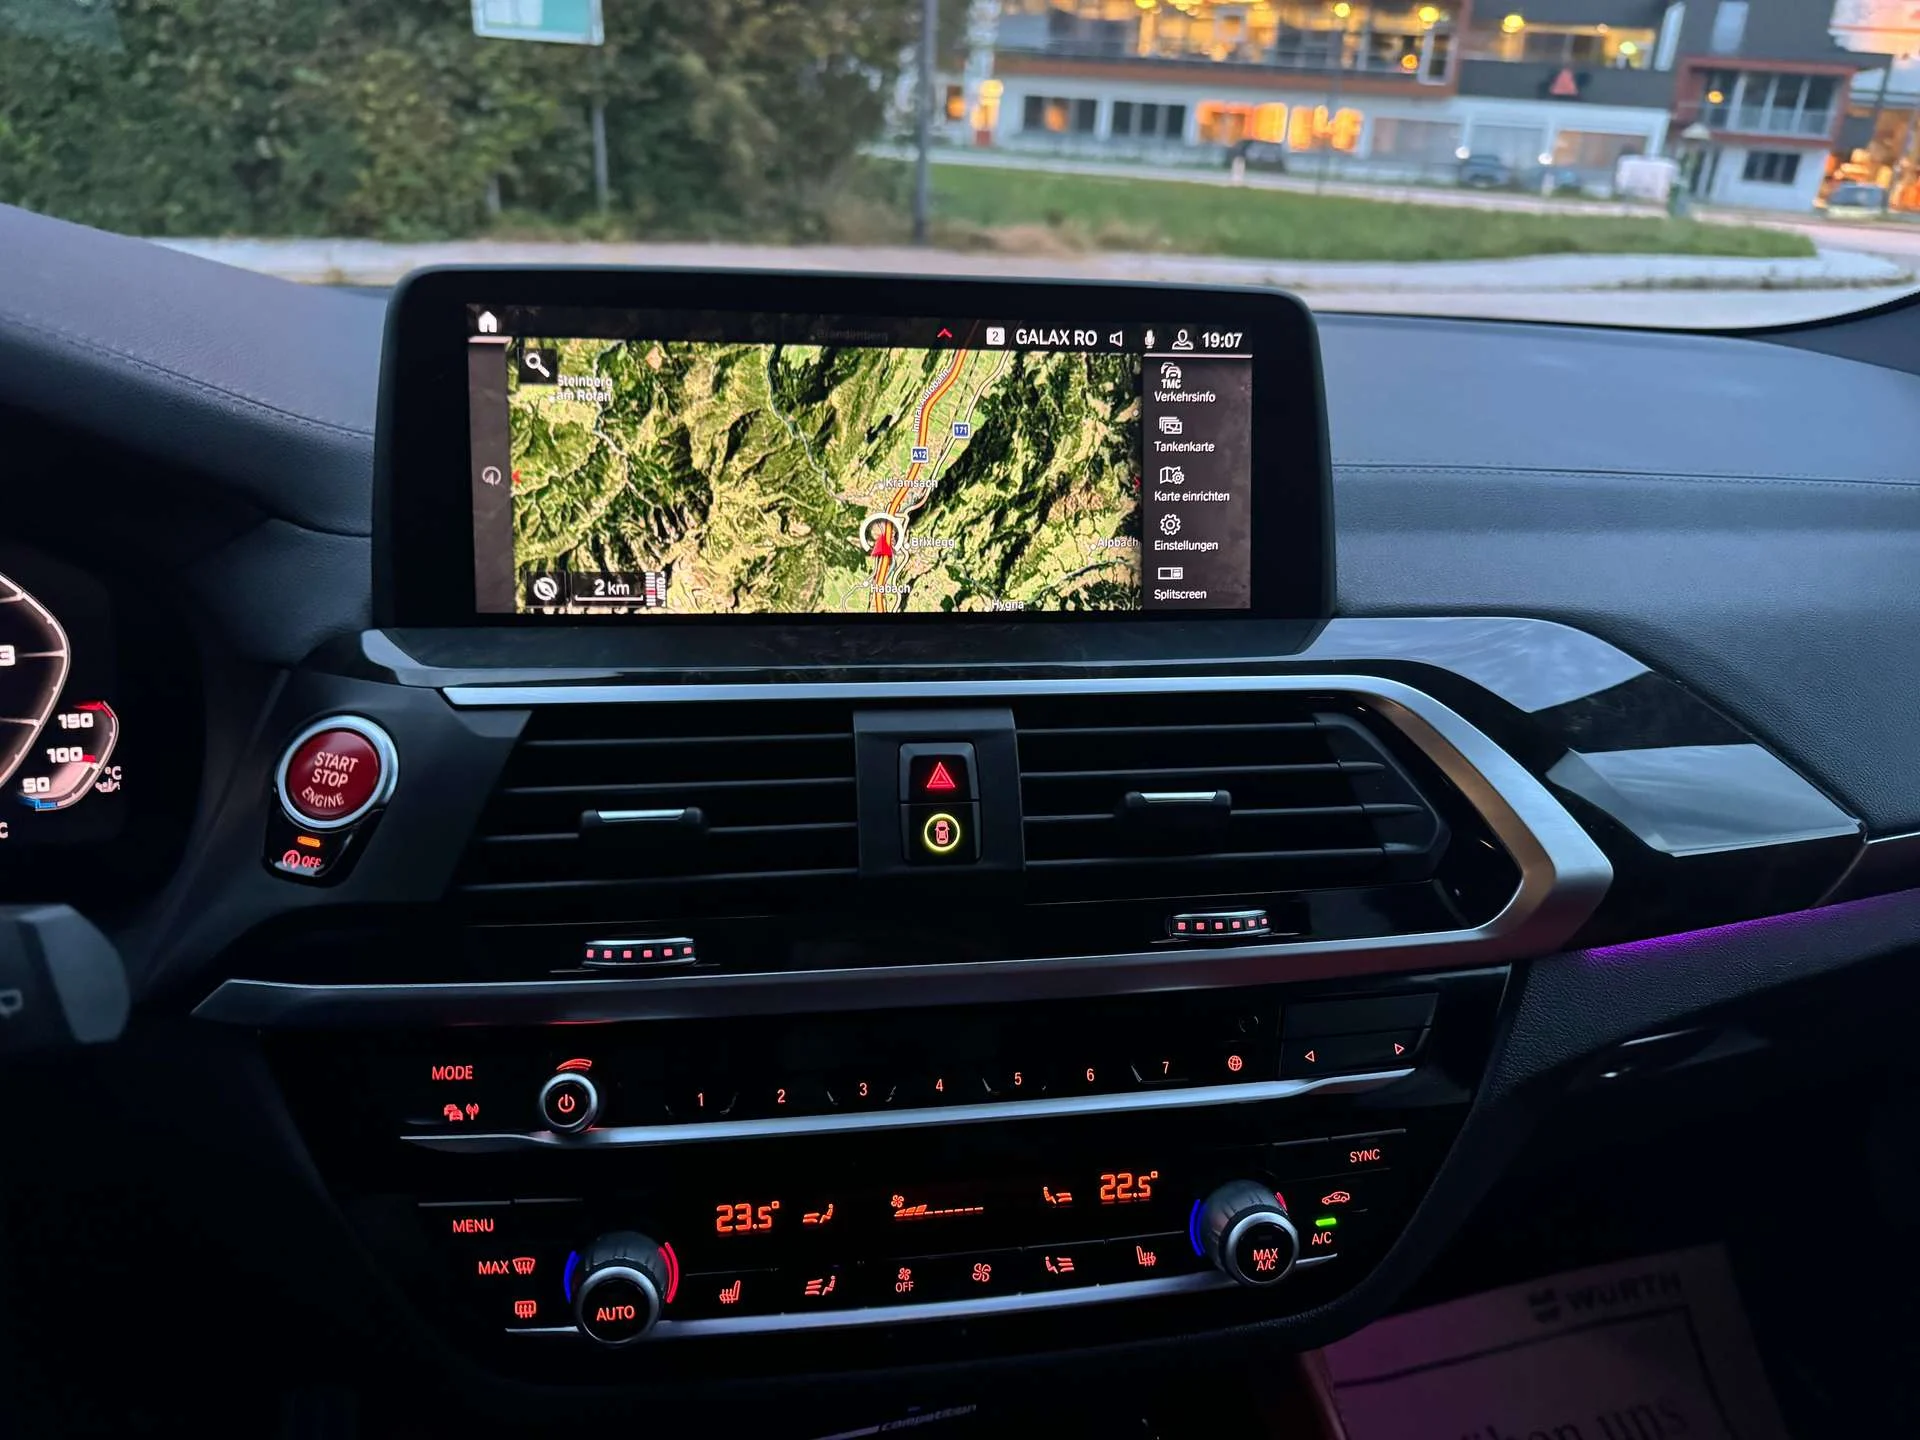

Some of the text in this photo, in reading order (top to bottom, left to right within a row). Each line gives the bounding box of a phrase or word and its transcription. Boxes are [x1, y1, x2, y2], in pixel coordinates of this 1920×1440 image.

[1016, 328, 1098, 347] GALAX RO
[1201, 332, 1243, 349] 19:07
[558, 374, 613, 389] Steinberg
[1161, 378, 1182, 389] TMC
[557, 391, 574, 401] am
[1154, 390, 1216, 403] Verkehrsinfo
[955, 426, 967, 436] 171
[913, 449, 927, 459] A12
[1154, 441, 1215, 452] Tankenkarte
[886, 479, 938, 488] Kramsach
[1154, 490, 1230, 502] Karte einrichten
[911, 537, 955, 548] Brixlegg
[1097, 536, 1139, 548] Alpbach
[1154, 540, 1219, 552] Einstellungen
[594, 579, 630, 596] 2 km
[1154, 589, 1207, 600] Splitscreen
[57, 713, 94, 729] 150
[46, 746, 83, 763] 100
[314, 751, 359, 773] START
[22, 776, 51, 793] 50
[311, 768, 349, 788] STOP
[301, 785, 345, 809] ENGINE
[301, 855, 322, 868] OFF
[431, 1065, 473, 1081] MODE
[1086, 1067, 1095, 1082] 6
[1162, 1061, 1170, 1074] 7
[935, 1078, 944, 1092] 4
[1014, 1071, 1022, 1086] 5
[777, 1088, 786, 1104] 2
[859, 1082, 868, 1097] 3
[697, 1092, 704, 1107] 1
[1349, 1148, 1380, 1163] SYNC
[452, 1218, 495, 1233] MENU
[1311, 1231, 1332, 1246] A/C
[1253, 1247, 1279, 1261] MAX
[478, 1260, 509, 1275] MAX
[1256, 1259, 1276, 1272] A/C
[895, 1281, 914, 1293] OFF
[596, 1304, 636, 1322] AUTO
